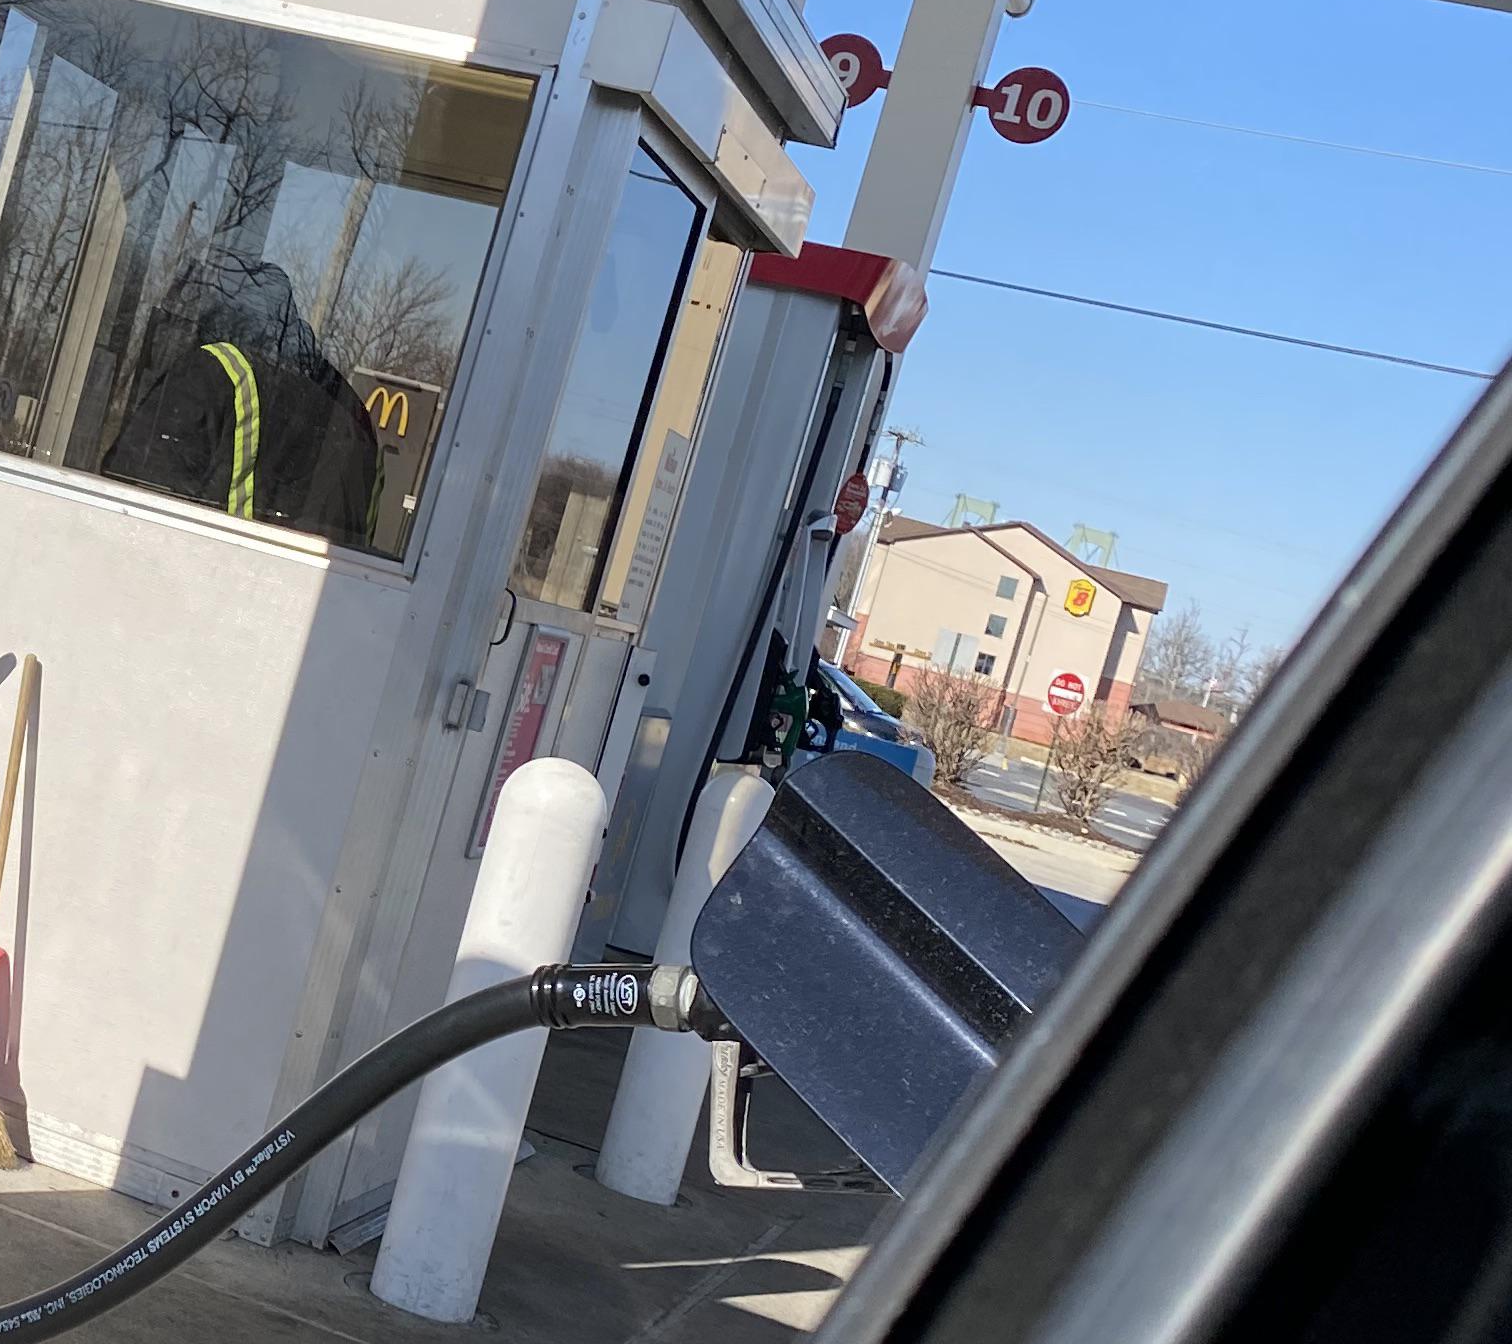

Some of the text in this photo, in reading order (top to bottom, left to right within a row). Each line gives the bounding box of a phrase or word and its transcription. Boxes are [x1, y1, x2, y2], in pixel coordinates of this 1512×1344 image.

[993, 83, 1063, 130] 10
[1073, 592, 1088, 606] 8
[1055, 678, 1082, 691] DO NOT
[229, 1169, 248, 1189] BY
[194, 1182, 235, 1218] VAPOR
[148, 1211, 196, 1253] SYSTEMS
